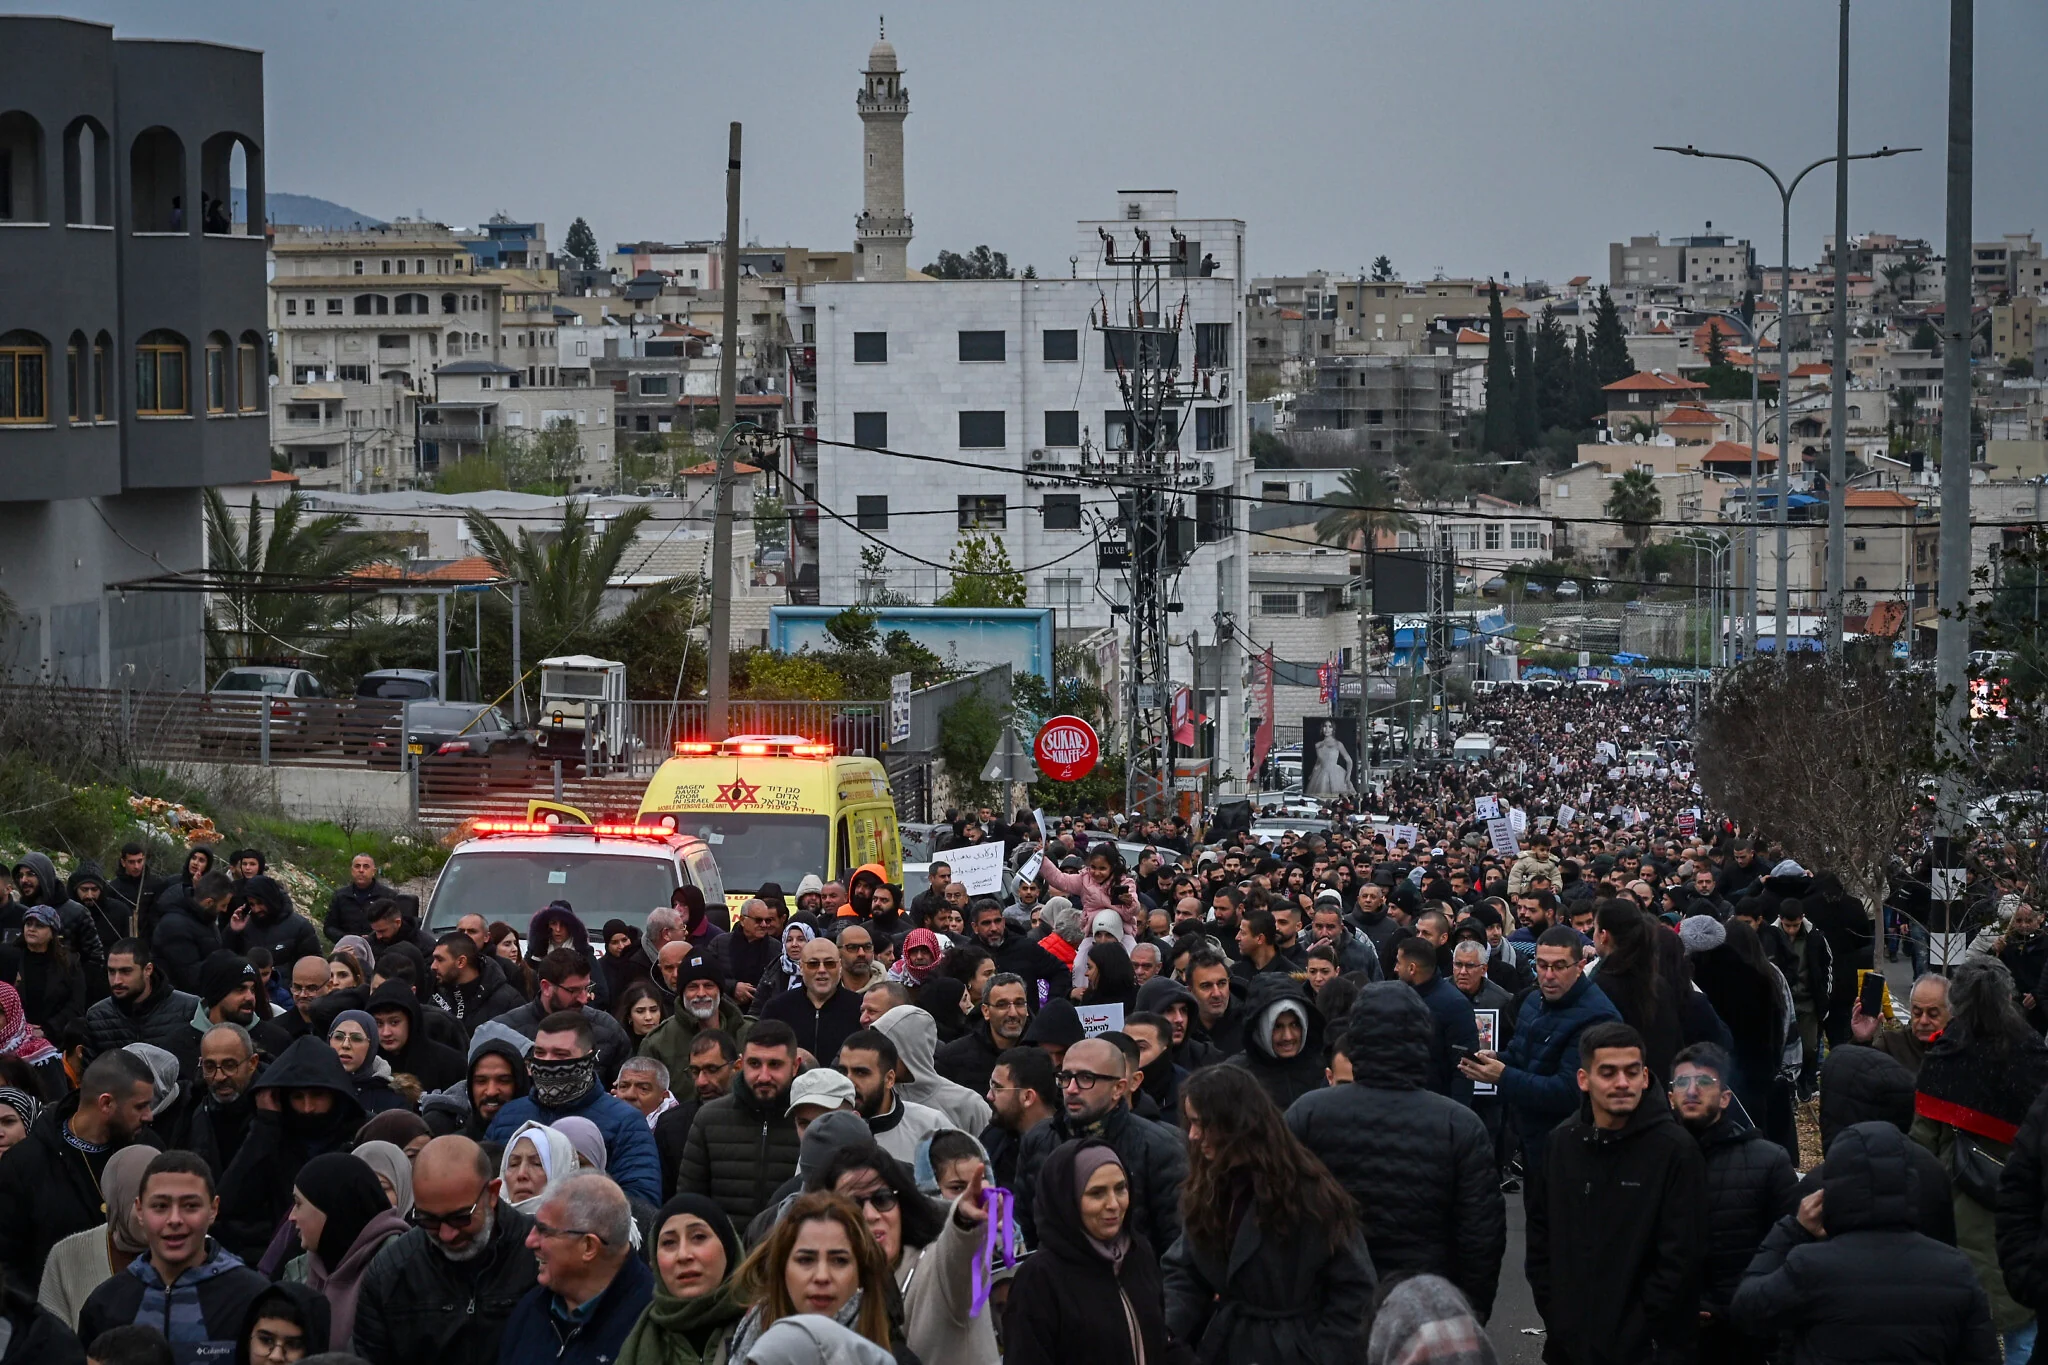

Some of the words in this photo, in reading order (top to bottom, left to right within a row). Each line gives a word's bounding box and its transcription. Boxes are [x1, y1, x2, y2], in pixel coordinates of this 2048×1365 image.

[1103, 546, 1125, 555] LUXE
[1046, 730, 1085, 751] SUKAR
[775, 792, 800, 801] אדום
[761, 797, 798, 807] בישראל
[766, 803, 791, 811] טיפול
[792, 805, 816, 814] ניידת
[1084, 1023, 1109, 1032] להיאבק
